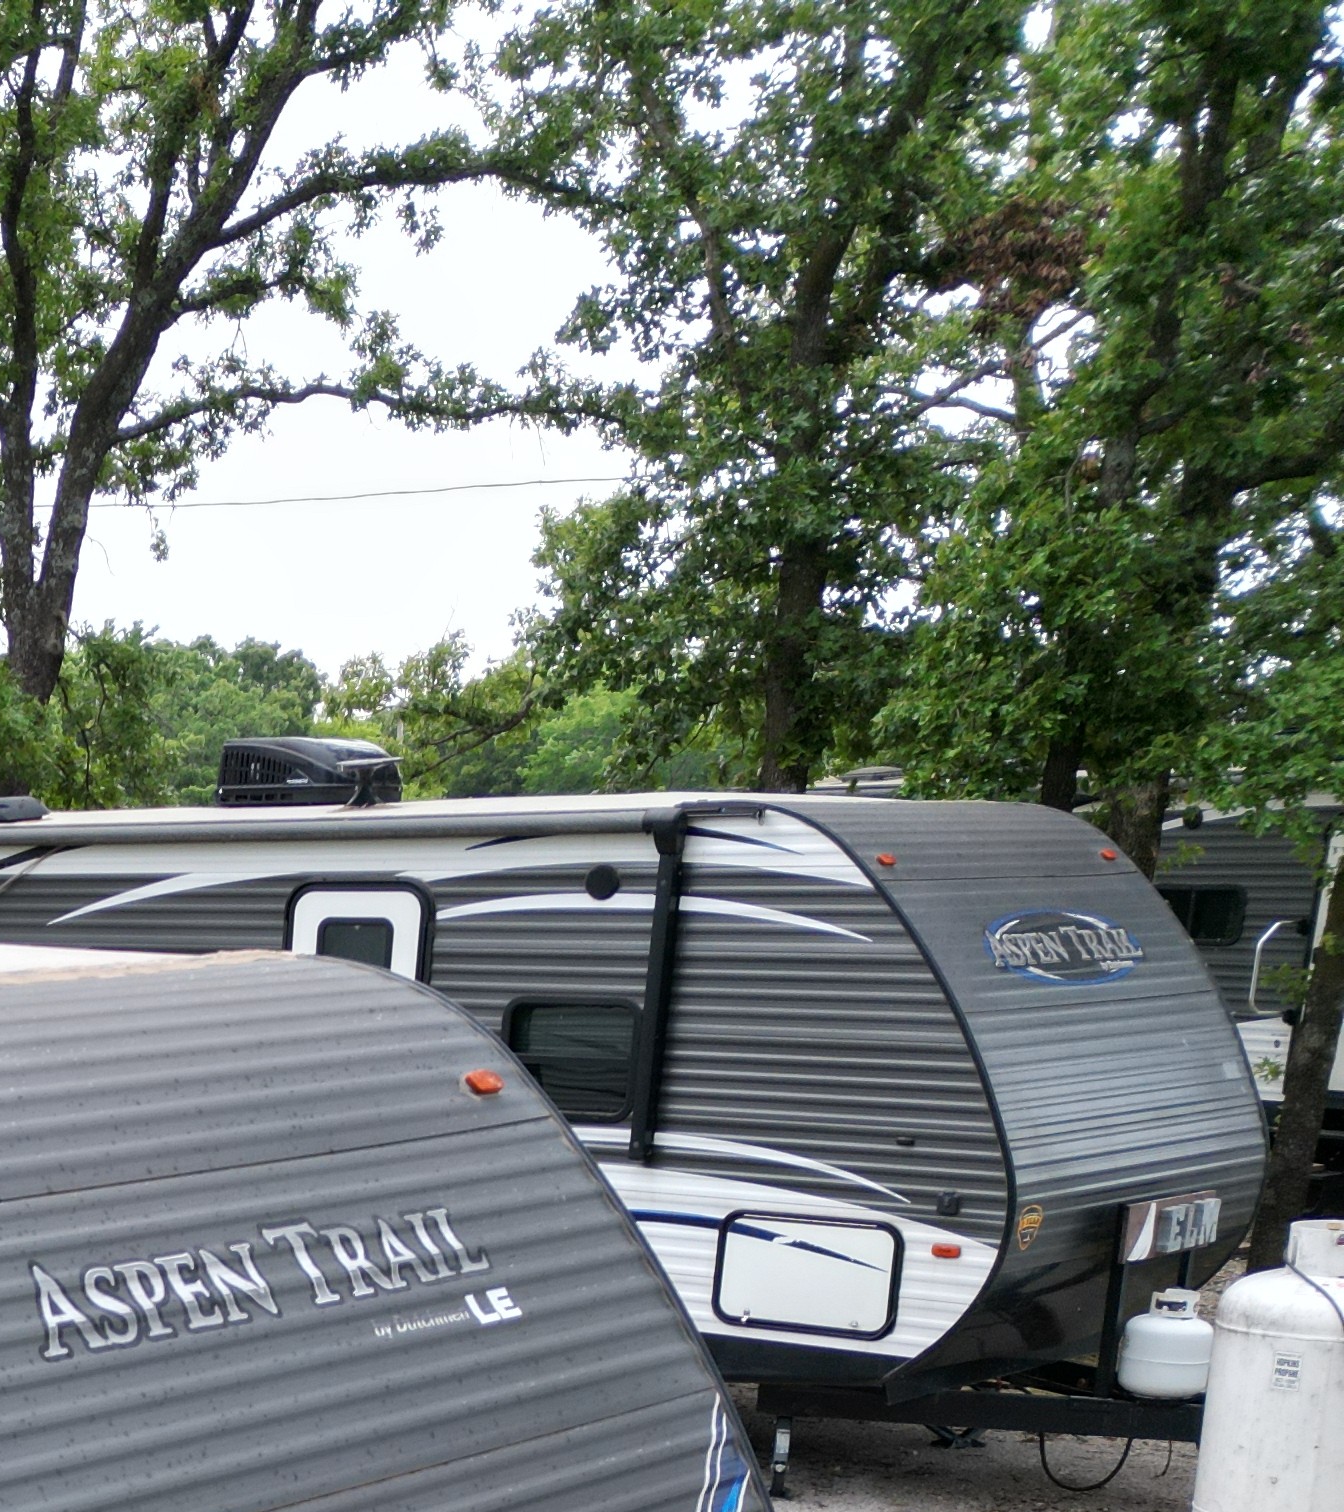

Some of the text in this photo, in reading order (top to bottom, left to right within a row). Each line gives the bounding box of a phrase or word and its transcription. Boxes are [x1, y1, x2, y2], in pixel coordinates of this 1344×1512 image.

[985, 926, 1143, 967] ASPEN TRAIL
[1157, 1198, 1221, 1253] ELM
[30, 1207, 490, 1359] ASPEN TRAIL
[464, 1286, 523, 1325] LE
